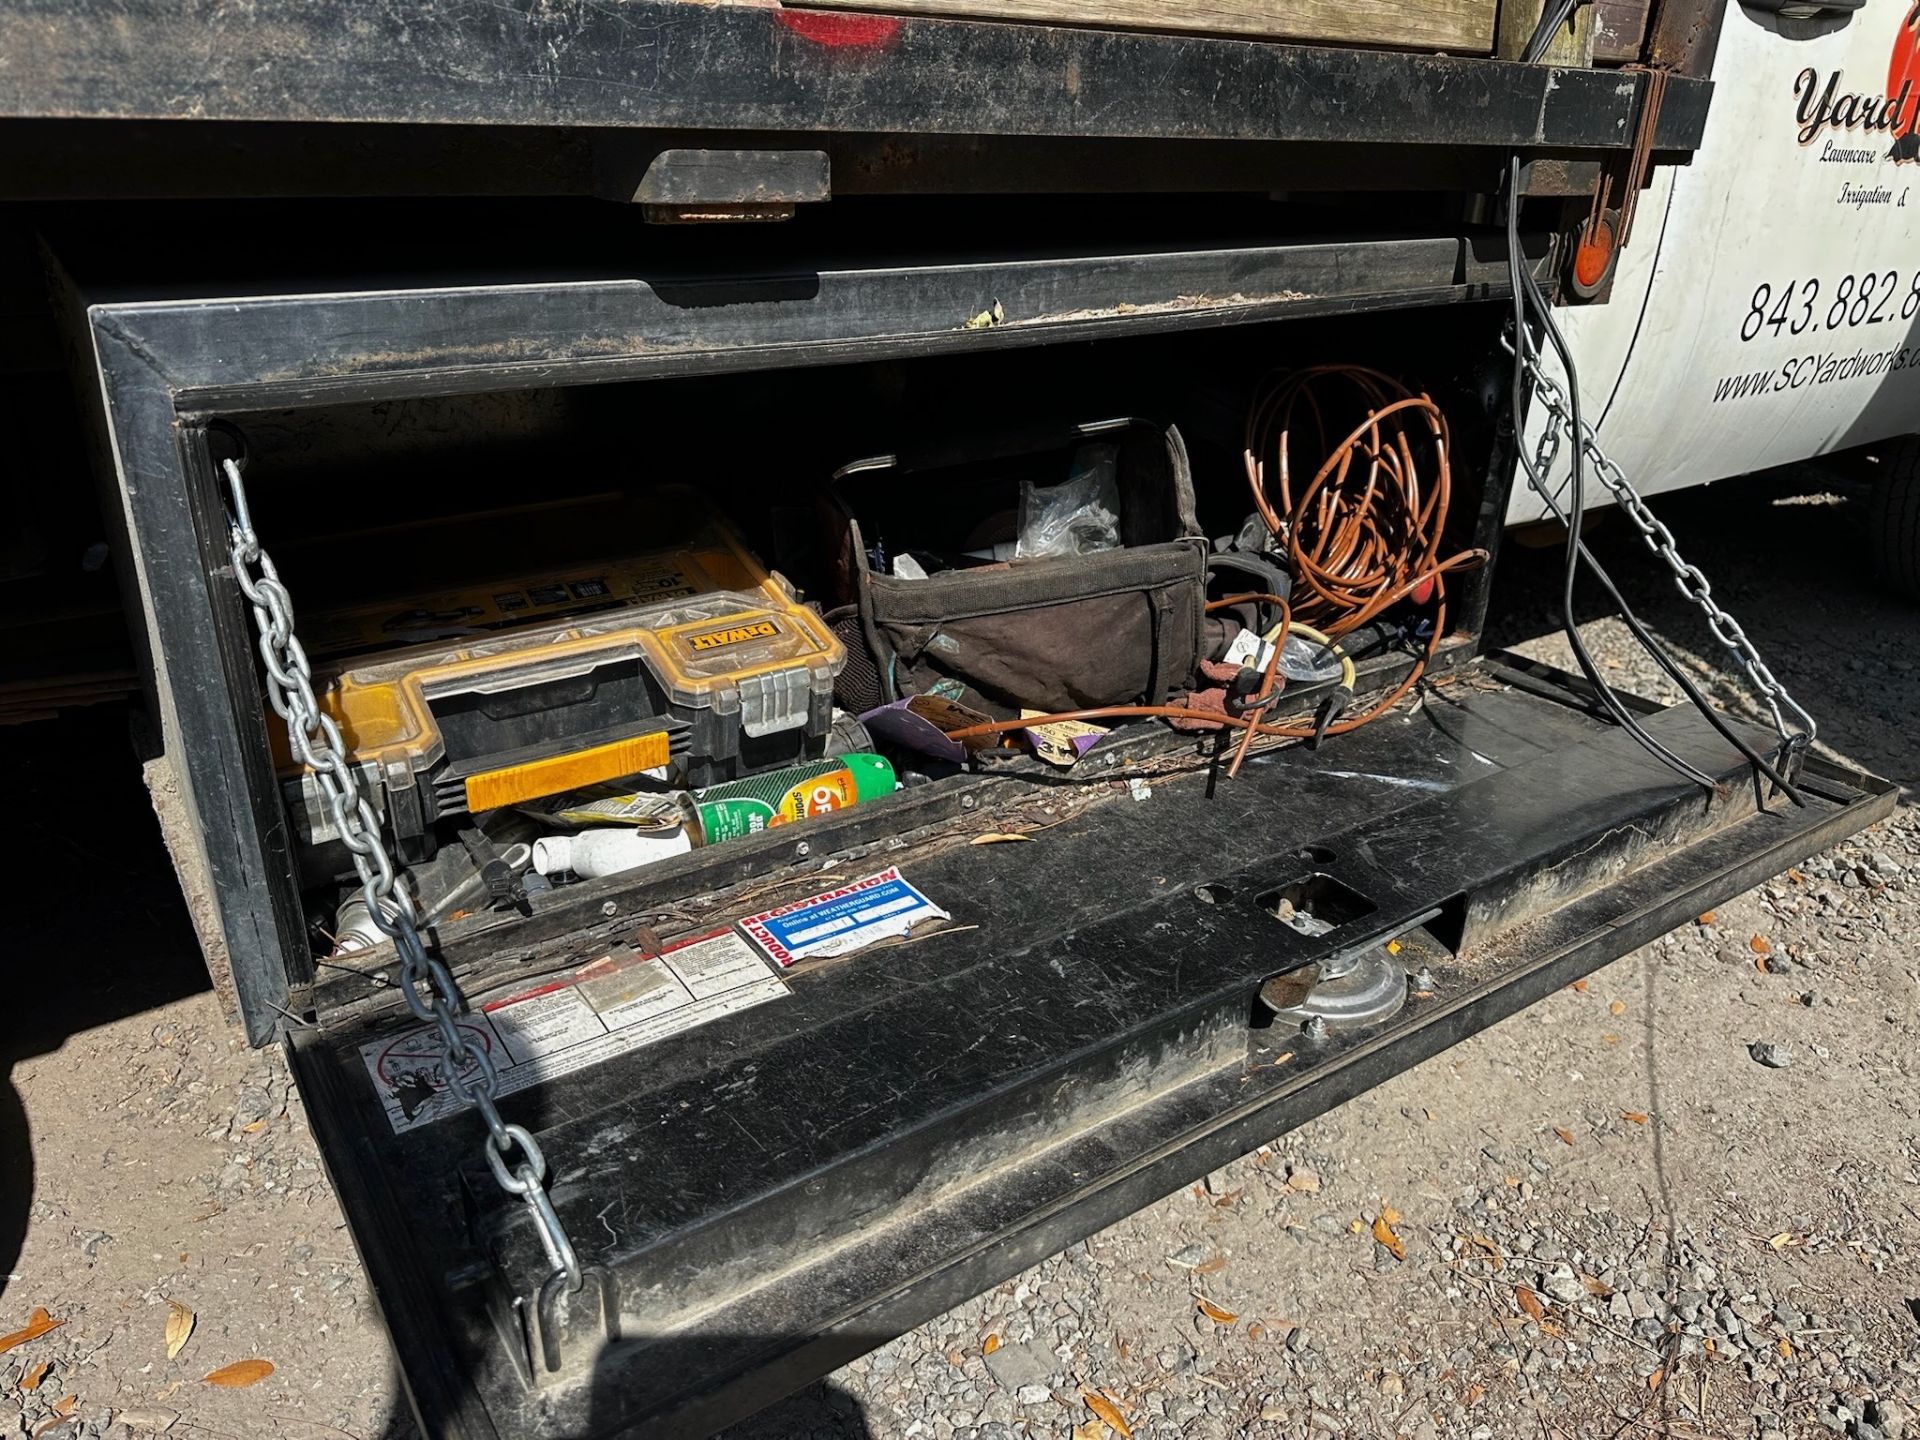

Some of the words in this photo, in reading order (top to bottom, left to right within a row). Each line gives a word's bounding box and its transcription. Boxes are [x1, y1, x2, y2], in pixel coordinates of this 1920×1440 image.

[1794, 67, 1912, 144] Yard
[1819, 139, 1876, 164] Lawncare
[1837, 182, 1892, 211] Irrigation
[1713, 342, 1920, 403] www.SCYardworks.c
[692, 621, 777, 651] DEWALT
[741, 869, 897, 927] REGISTRATION
[782, 916, 808, 928] Online
[809, 912, 818, 920] at
[818, 887, 899, 917] WEATHERGUARD.COM
